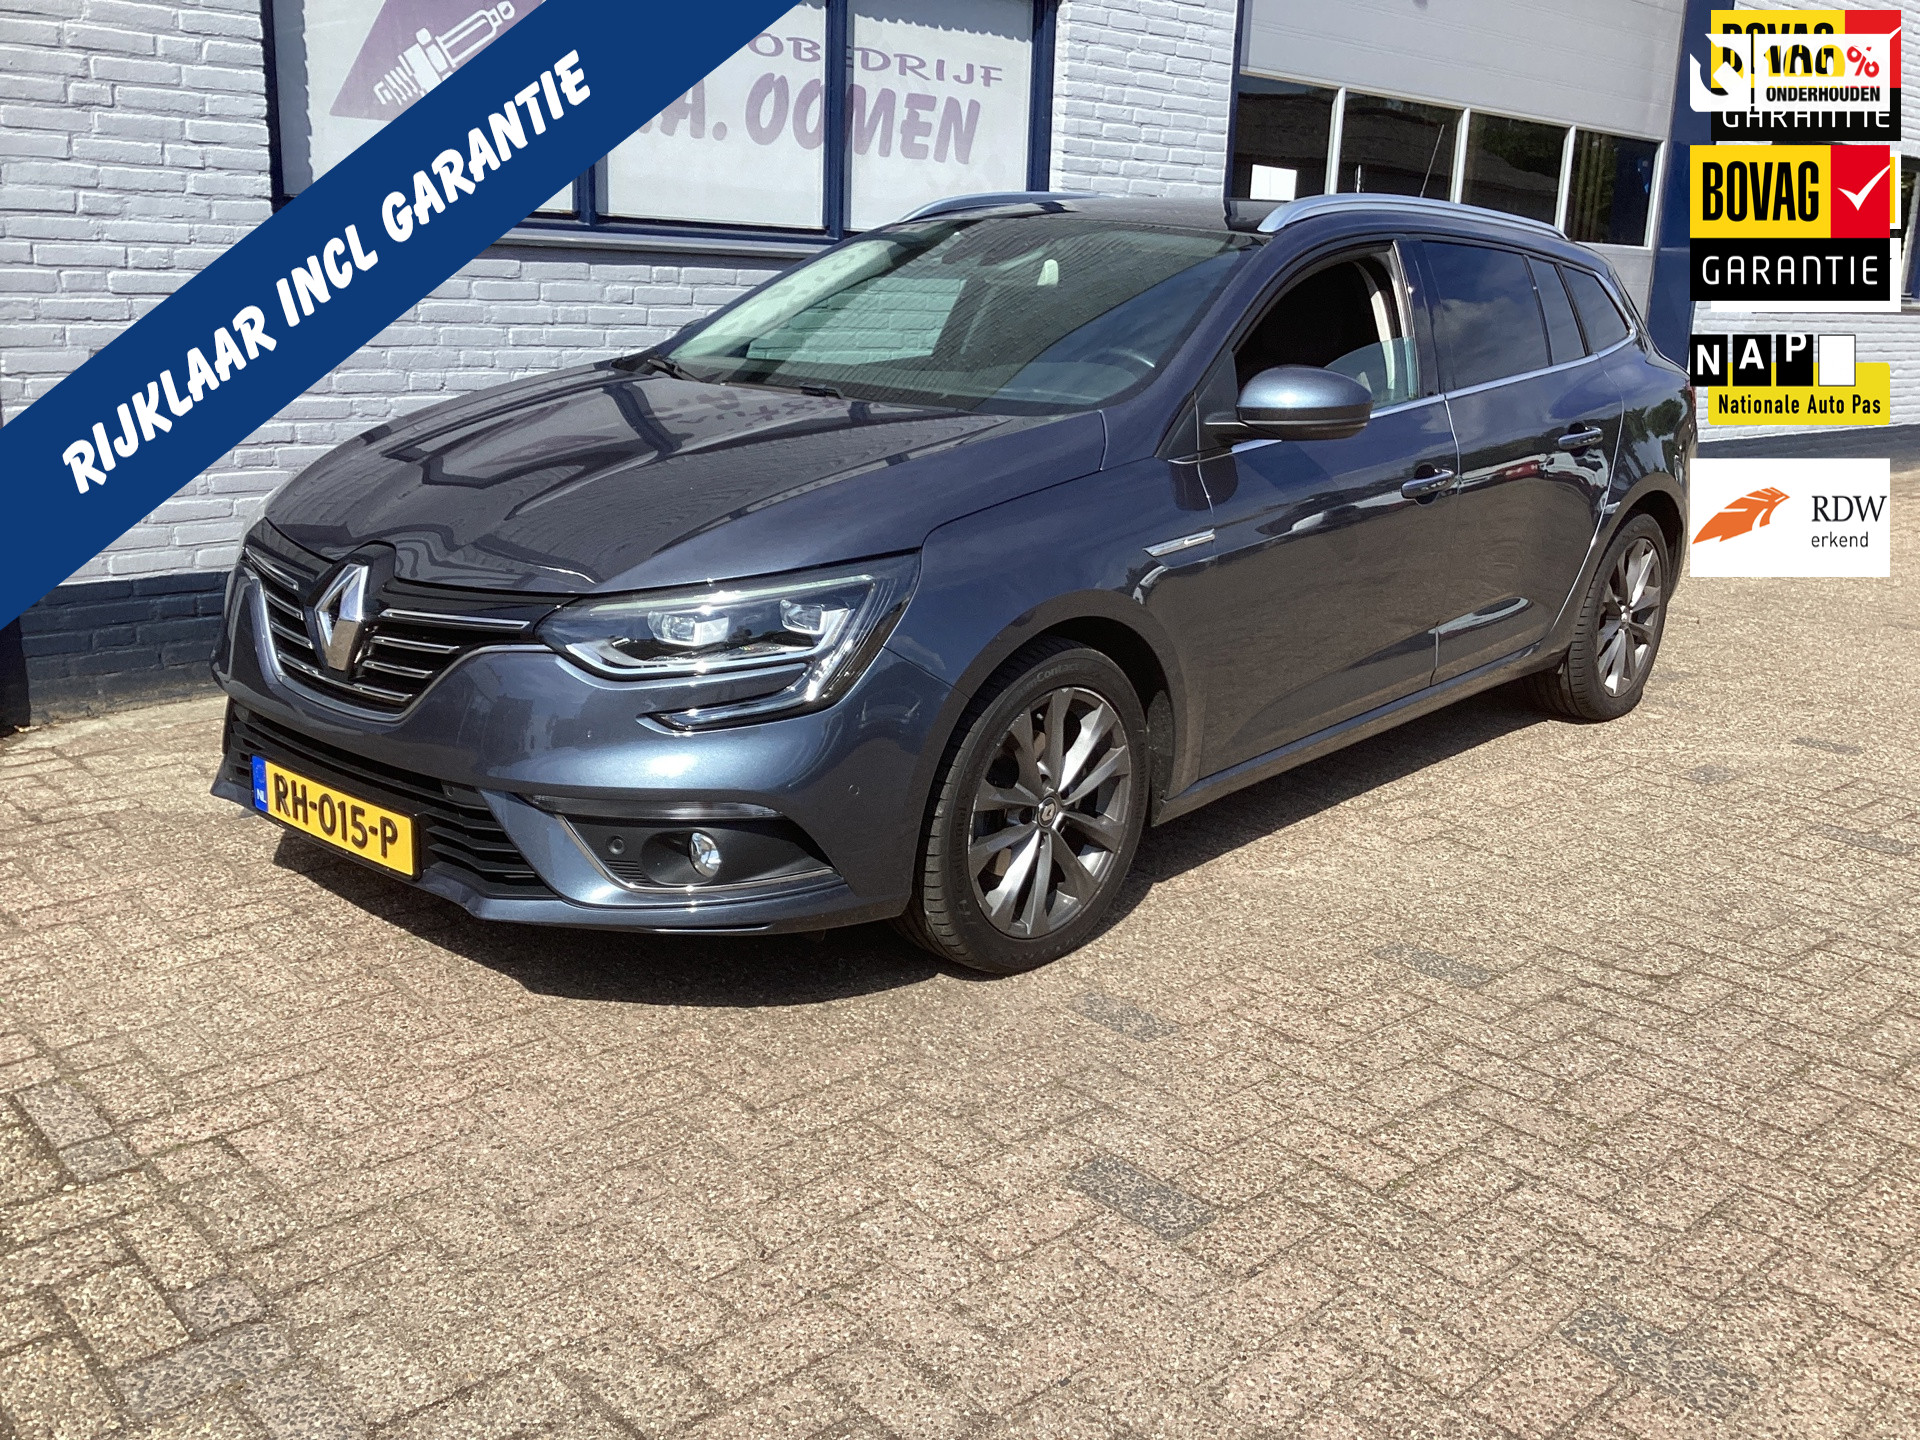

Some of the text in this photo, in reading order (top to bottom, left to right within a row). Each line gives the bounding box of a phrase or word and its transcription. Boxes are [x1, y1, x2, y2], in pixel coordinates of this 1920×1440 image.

[745, 72, 981, 165] OOMEN
[256, 788, 267, 804] NL
[273, 772, 399, 859] RH-015-P
